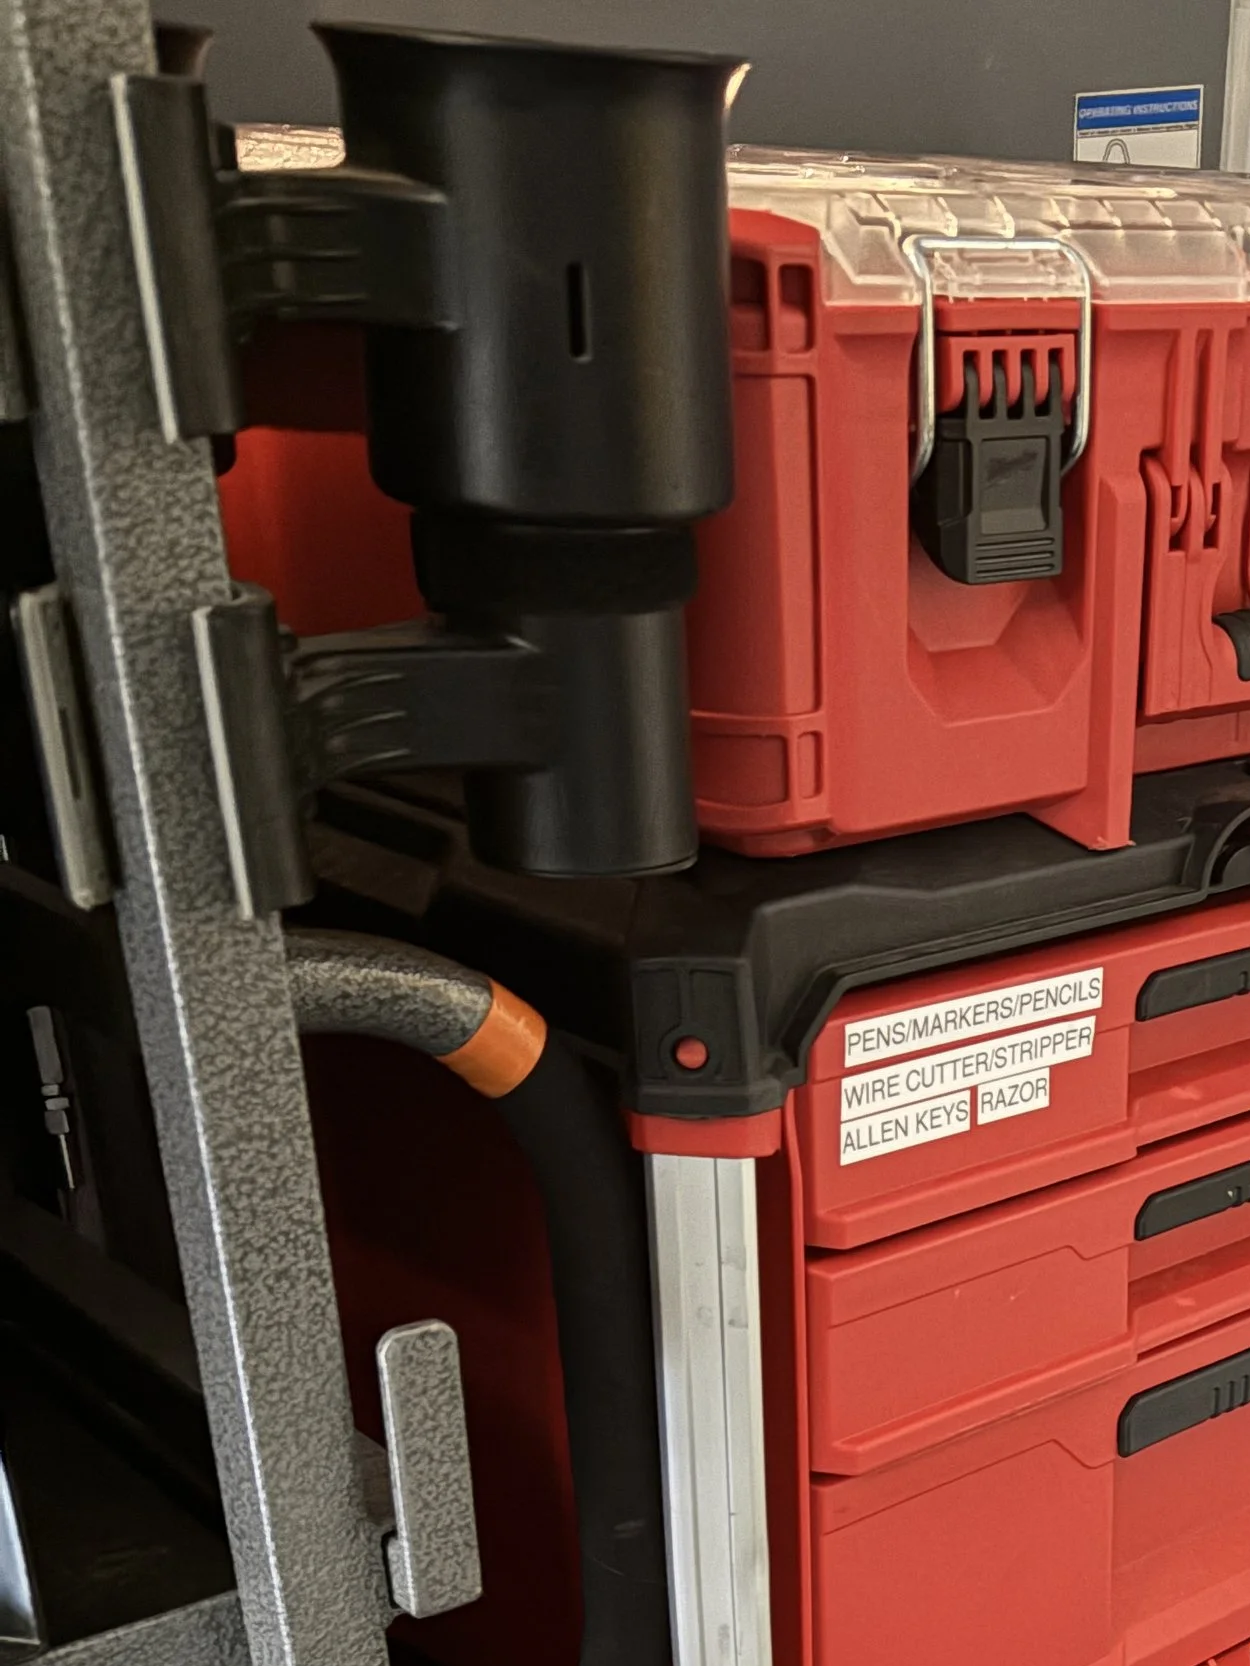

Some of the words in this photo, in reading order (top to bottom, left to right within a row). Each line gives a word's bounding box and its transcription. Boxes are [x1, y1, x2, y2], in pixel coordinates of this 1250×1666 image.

[847, 978, 1101, 1056] PENS/MARKERS/PENCILS
[844, 1074, 900, 1109] WIRE
[905, 1026, 1092, 1094] CUTTER/STRIPPER
[981, 1077, 1048, 1114] RAZOR
[842, 1118, 909, 1154] ALLEN
[915, 1100, 969, 1134] KEYS
